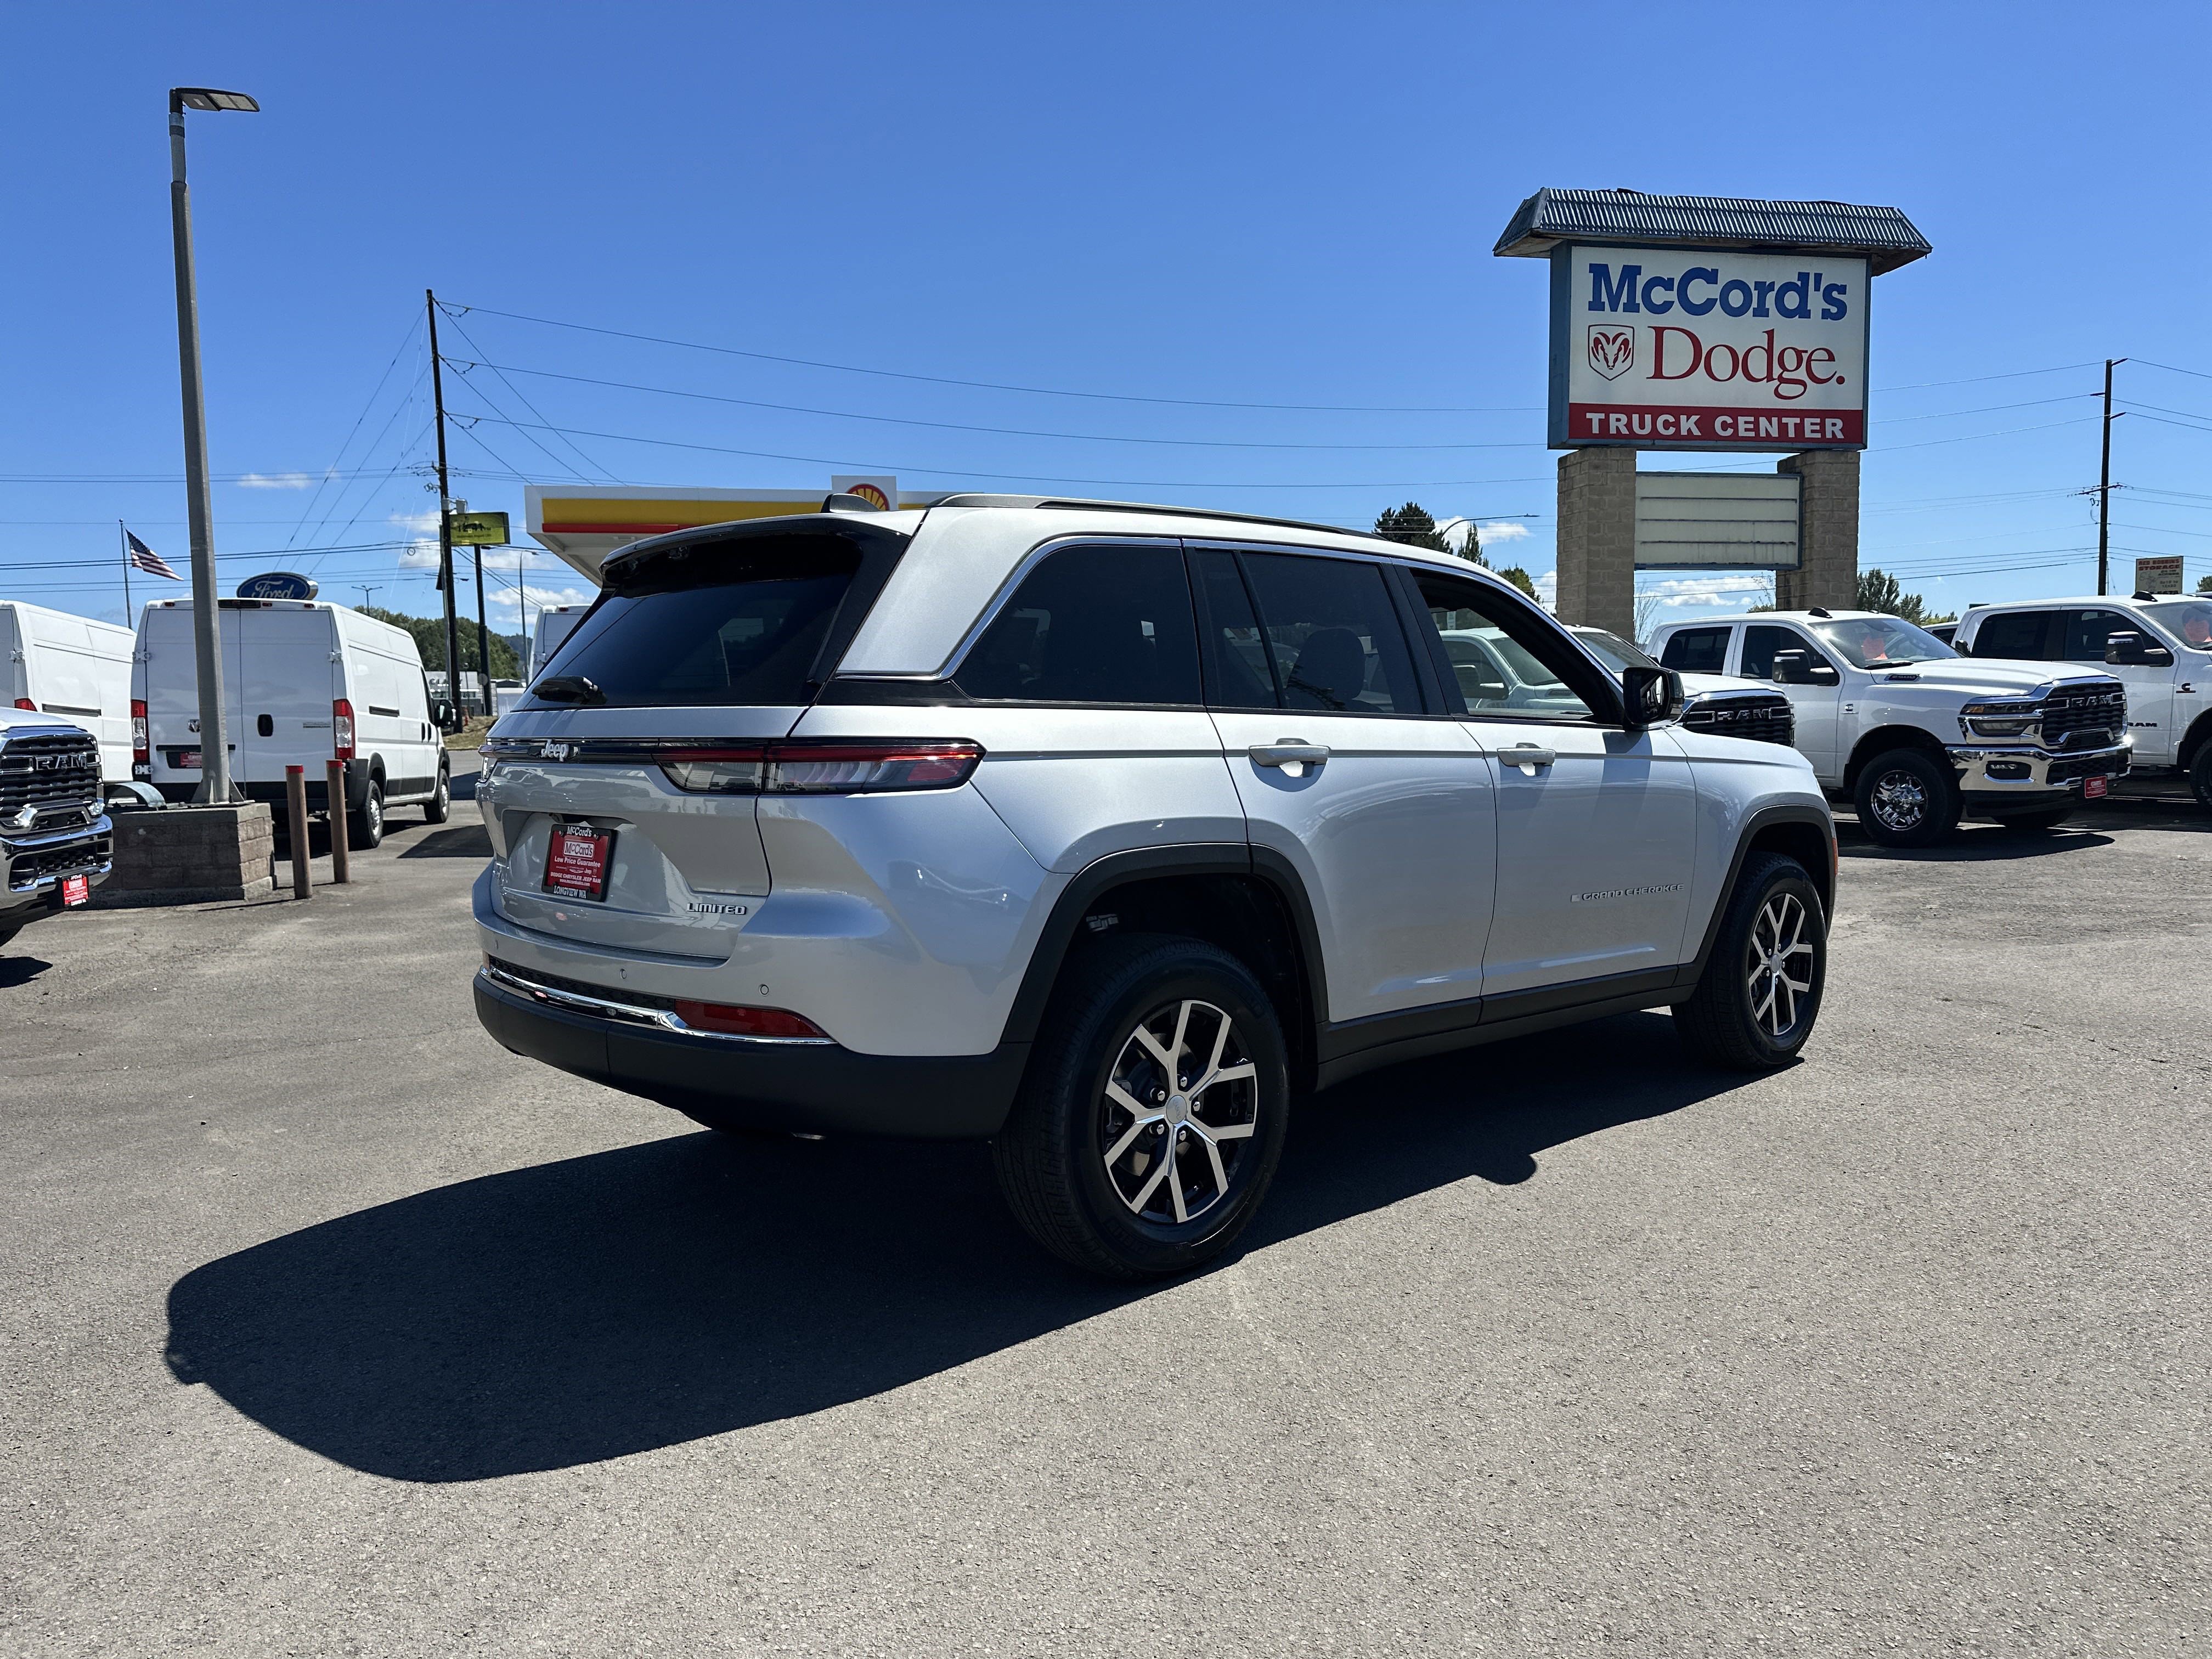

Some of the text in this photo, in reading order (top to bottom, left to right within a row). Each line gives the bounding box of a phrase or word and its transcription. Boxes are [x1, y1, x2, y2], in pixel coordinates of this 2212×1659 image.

[1588, 263, 1848, 321] McCord's
[1646, 326, 1845, 400] Dodge.
[1586, 413, 1844, 439] TRUCK CENTER
[251, 580, 295, 599] Ford
[2072, 694, 2113, 707] RAM
[1717, 708, 1771, 720] RAM
[541, 738, 569, 761] Jeep
[35, 754, 87, 770] RAM
[567, 826, 592, 837] McCord's
[565, 843, 593, 856] McCord's
[577, 859, 601, 867] Guarantee
[554, 885, 586, 898] LONGVIEW WA
[1582, 884, 1685, 900] GRAND CHEROKEE
[687, 902, 747, 915] LIMITED
